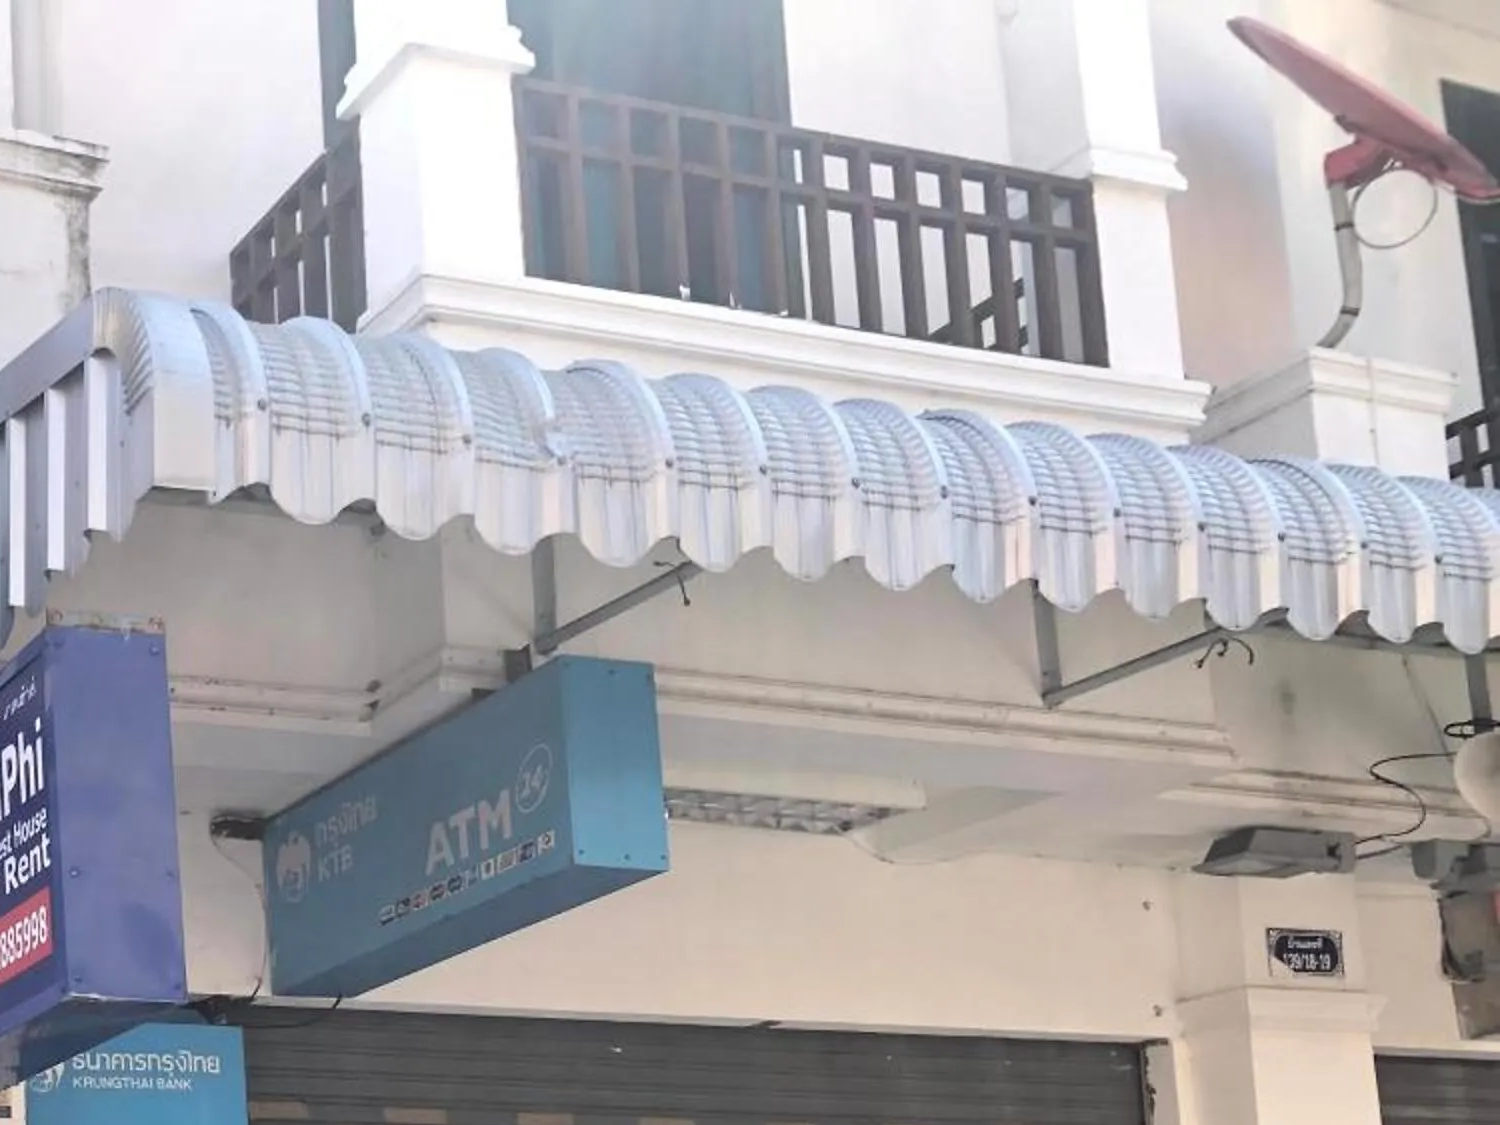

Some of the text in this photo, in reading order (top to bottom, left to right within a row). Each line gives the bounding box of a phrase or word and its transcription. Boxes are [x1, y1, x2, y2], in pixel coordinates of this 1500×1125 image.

[12, 807, 48, 848] House
[425, 788, 514, 877] ATM
[4, 833, 51, 895] Rent
[317, 845, 354, 882] KTB
[72, 1050, 221, 1077] ธนาคารกรุงไทย
[72, 1076, 193, 1091] KRUNGTHAI BANK
